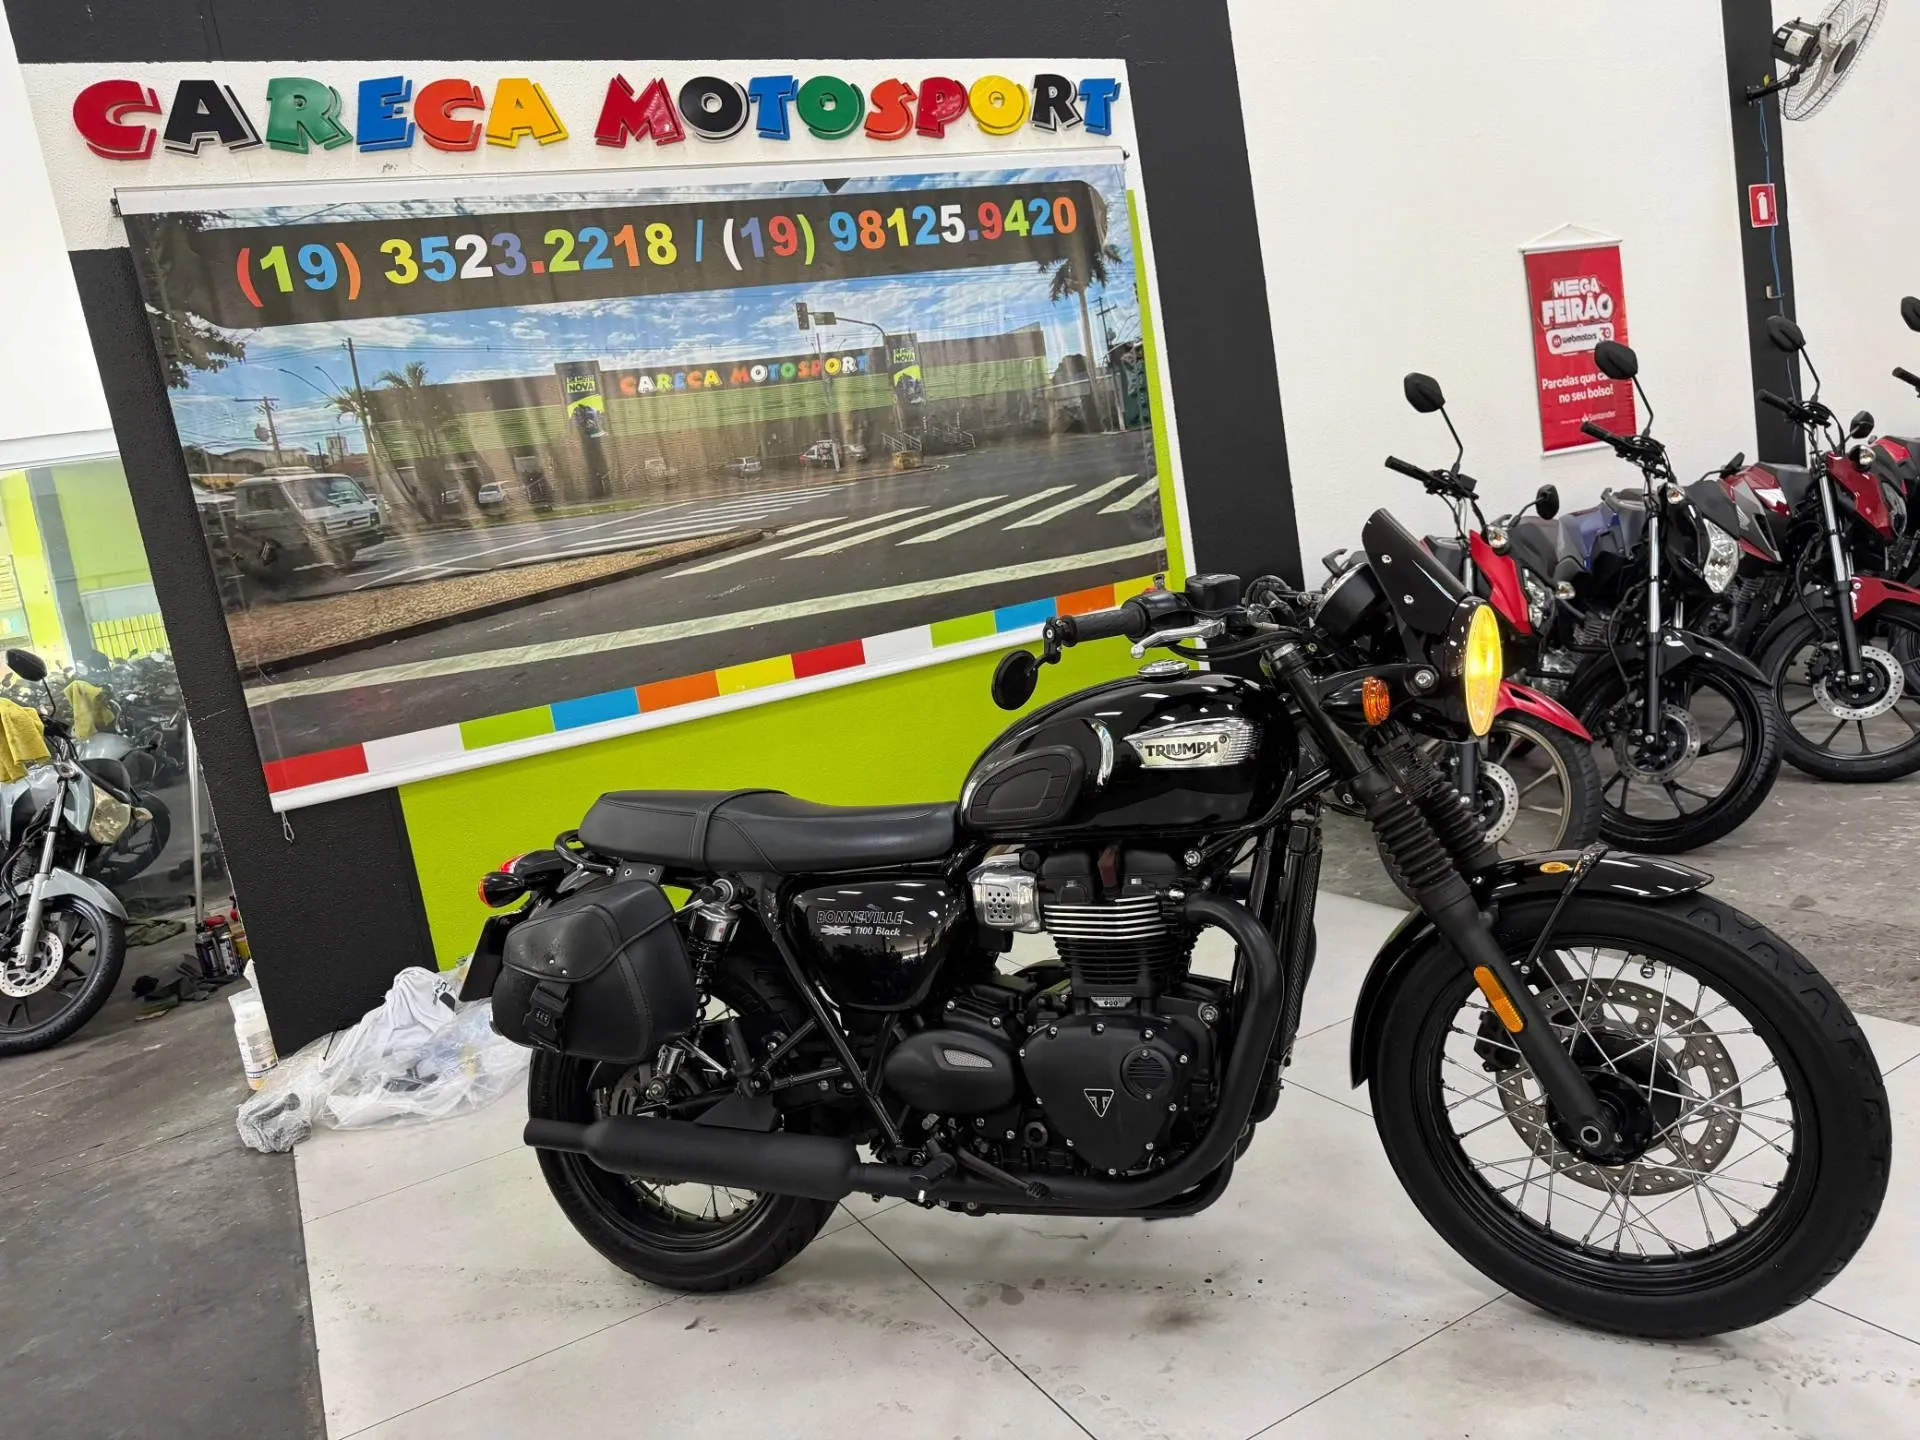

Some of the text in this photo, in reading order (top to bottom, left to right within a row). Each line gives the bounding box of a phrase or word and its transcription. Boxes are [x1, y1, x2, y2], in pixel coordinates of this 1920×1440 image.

[72, 73, 1121, 160] CARECA MOTOSPORT
[236, 196, 1077, 308] (19) 3523.2218 / (19) 98125.9420
[1553, 277, 1600, 298] MEGA
[1541, 292, 1613, 326] FEIRÃO
[1562, 332, 1598, 344] webmotors
[620, 352, 869, 396] CARECA MOTOSPORT
[1541, 375, 1580, 390] Parcelas
[1580, 373, 1596, 387] que
[568, 382, 593, 392] NOVA
[1559, 384, 1614, 404] no seu bolso!
[1145, 741, 1218, 761] TRIUMPH
[816, 910, 905, 924] BONNEVILLE
[855, 926, 901, 936] T100 Black
